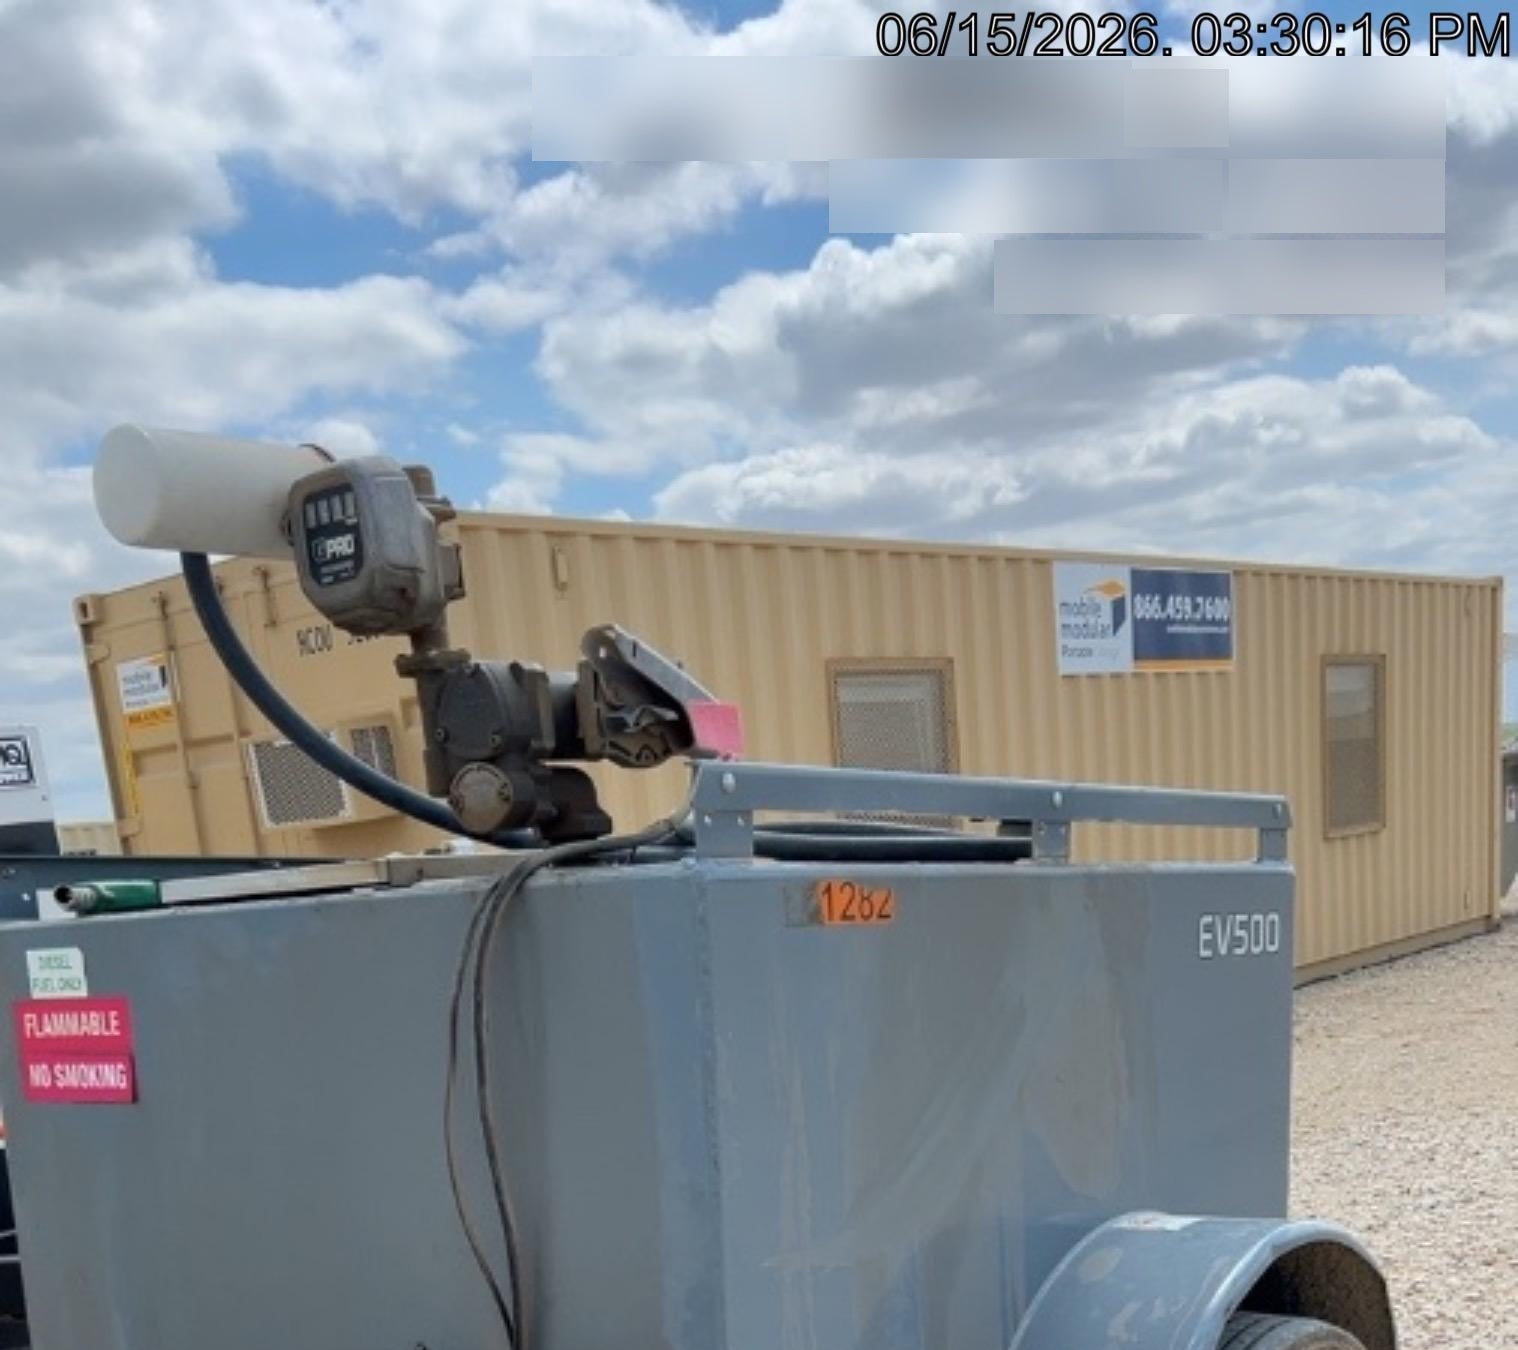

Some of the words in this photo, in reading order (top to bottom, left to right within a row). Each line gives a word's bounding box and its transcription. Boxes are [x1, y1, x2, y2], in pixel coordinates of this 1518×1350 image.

[1060, 596, 1102, 618] mobile
[1132, 592, 1230, 621] 866.459.7600
[1061, 619, 1112, 640] modular
[821, 881, 892, 922] 1282
[1199, 911, 1280, 958] EV500
[23, 1010, 121, 1039] FLAMMABLE
[28, 1063, 52, 1088] NO
[54, 1061, 128, 1090] SMOKING
